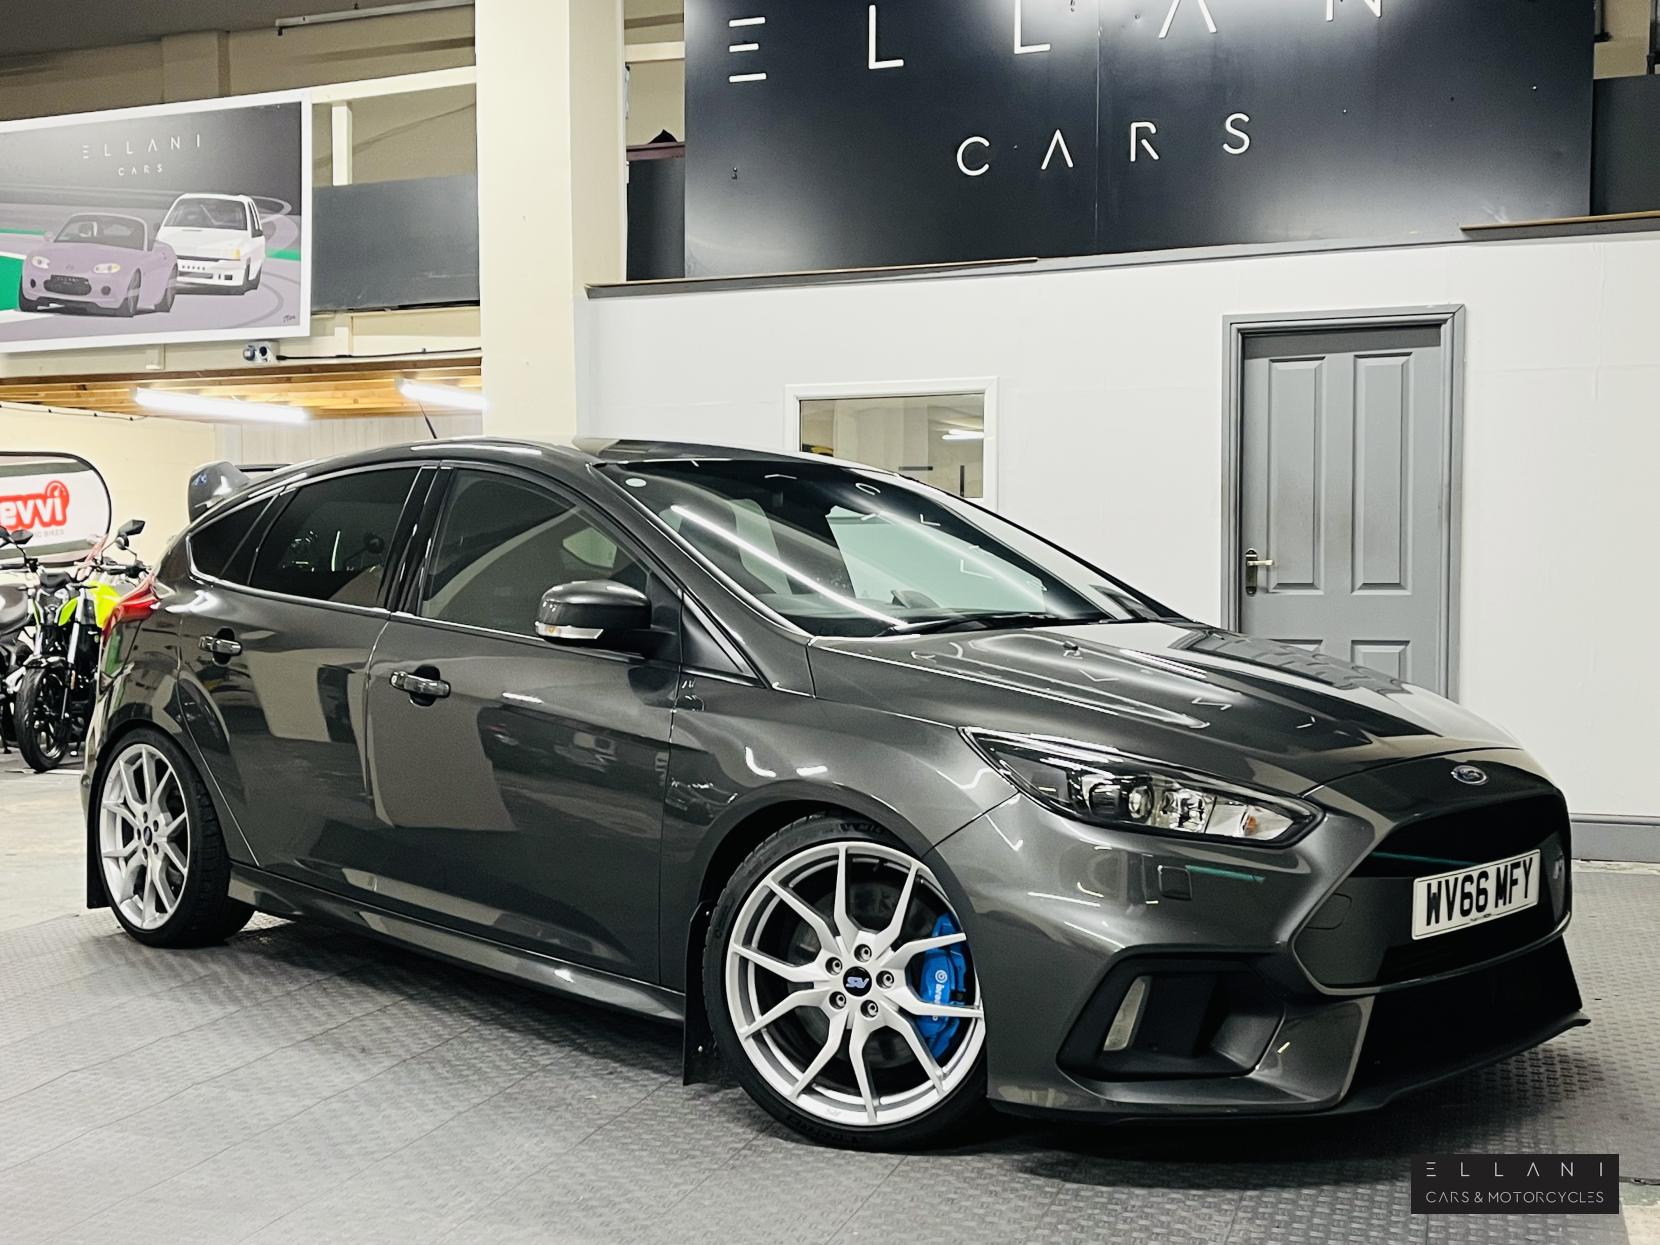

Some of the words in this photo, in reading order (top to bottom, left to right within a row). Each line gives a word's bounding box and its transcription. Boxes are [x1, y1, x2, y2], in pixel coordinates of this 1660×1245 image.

[82, 133, 200, 159] ELLANI
[956, 112, 1251, 176] CARS
[118, 163, 163, 176] CARS
[1426, 870, 1489, 926] WV66
[1494, 857, 1533, 908] MFY
